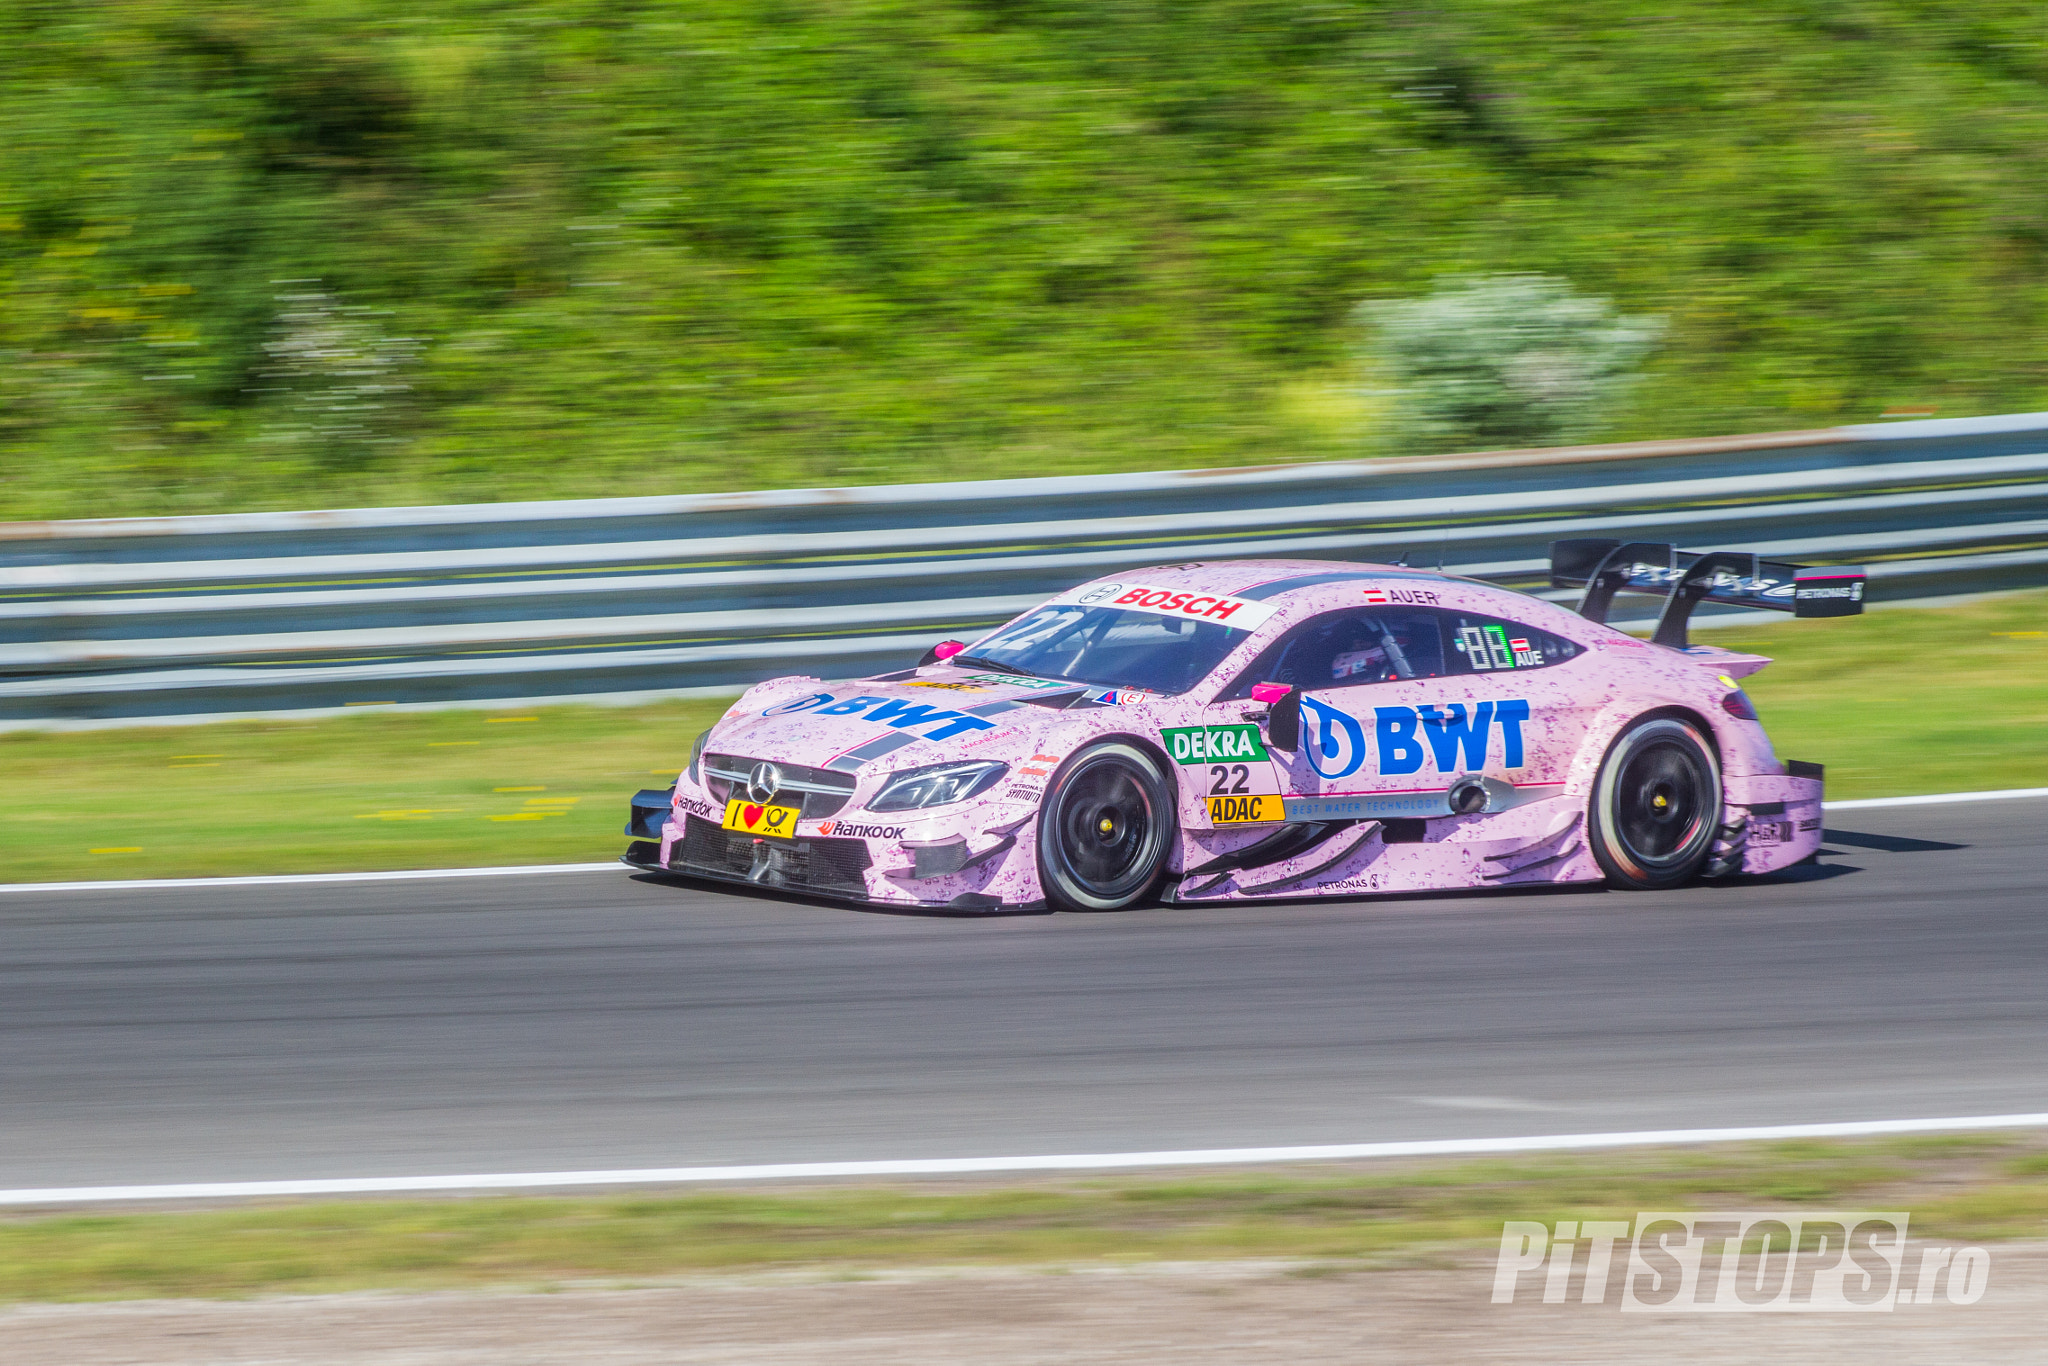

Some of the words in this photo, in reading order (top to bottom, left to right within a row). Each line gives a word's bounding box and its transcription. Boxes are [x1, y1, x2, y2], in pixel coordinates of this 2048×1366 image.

[1114, 588, 1242, 619] BOSCH
[1390, 590, 1440, 605] AUER
[1515, 651, 1545, 667] AUE
[811, 696, 998, 741] BWT
[1174, 730, 1255, 760] DEKRA
[1373, 699, 1530, 775] BWT
[1210, 764, 1250, 795] 22
[731, 803, 742, 827] I
[1211, 797, 1263, 821] ADAC
[1292, 804, 1319, 815] BEST
[1325, 802, 1360, 813] WATER
[1367, 799, 1439, 811] TECHNOLOGY
[1317, 879, 1368, 890] PETRONAS
